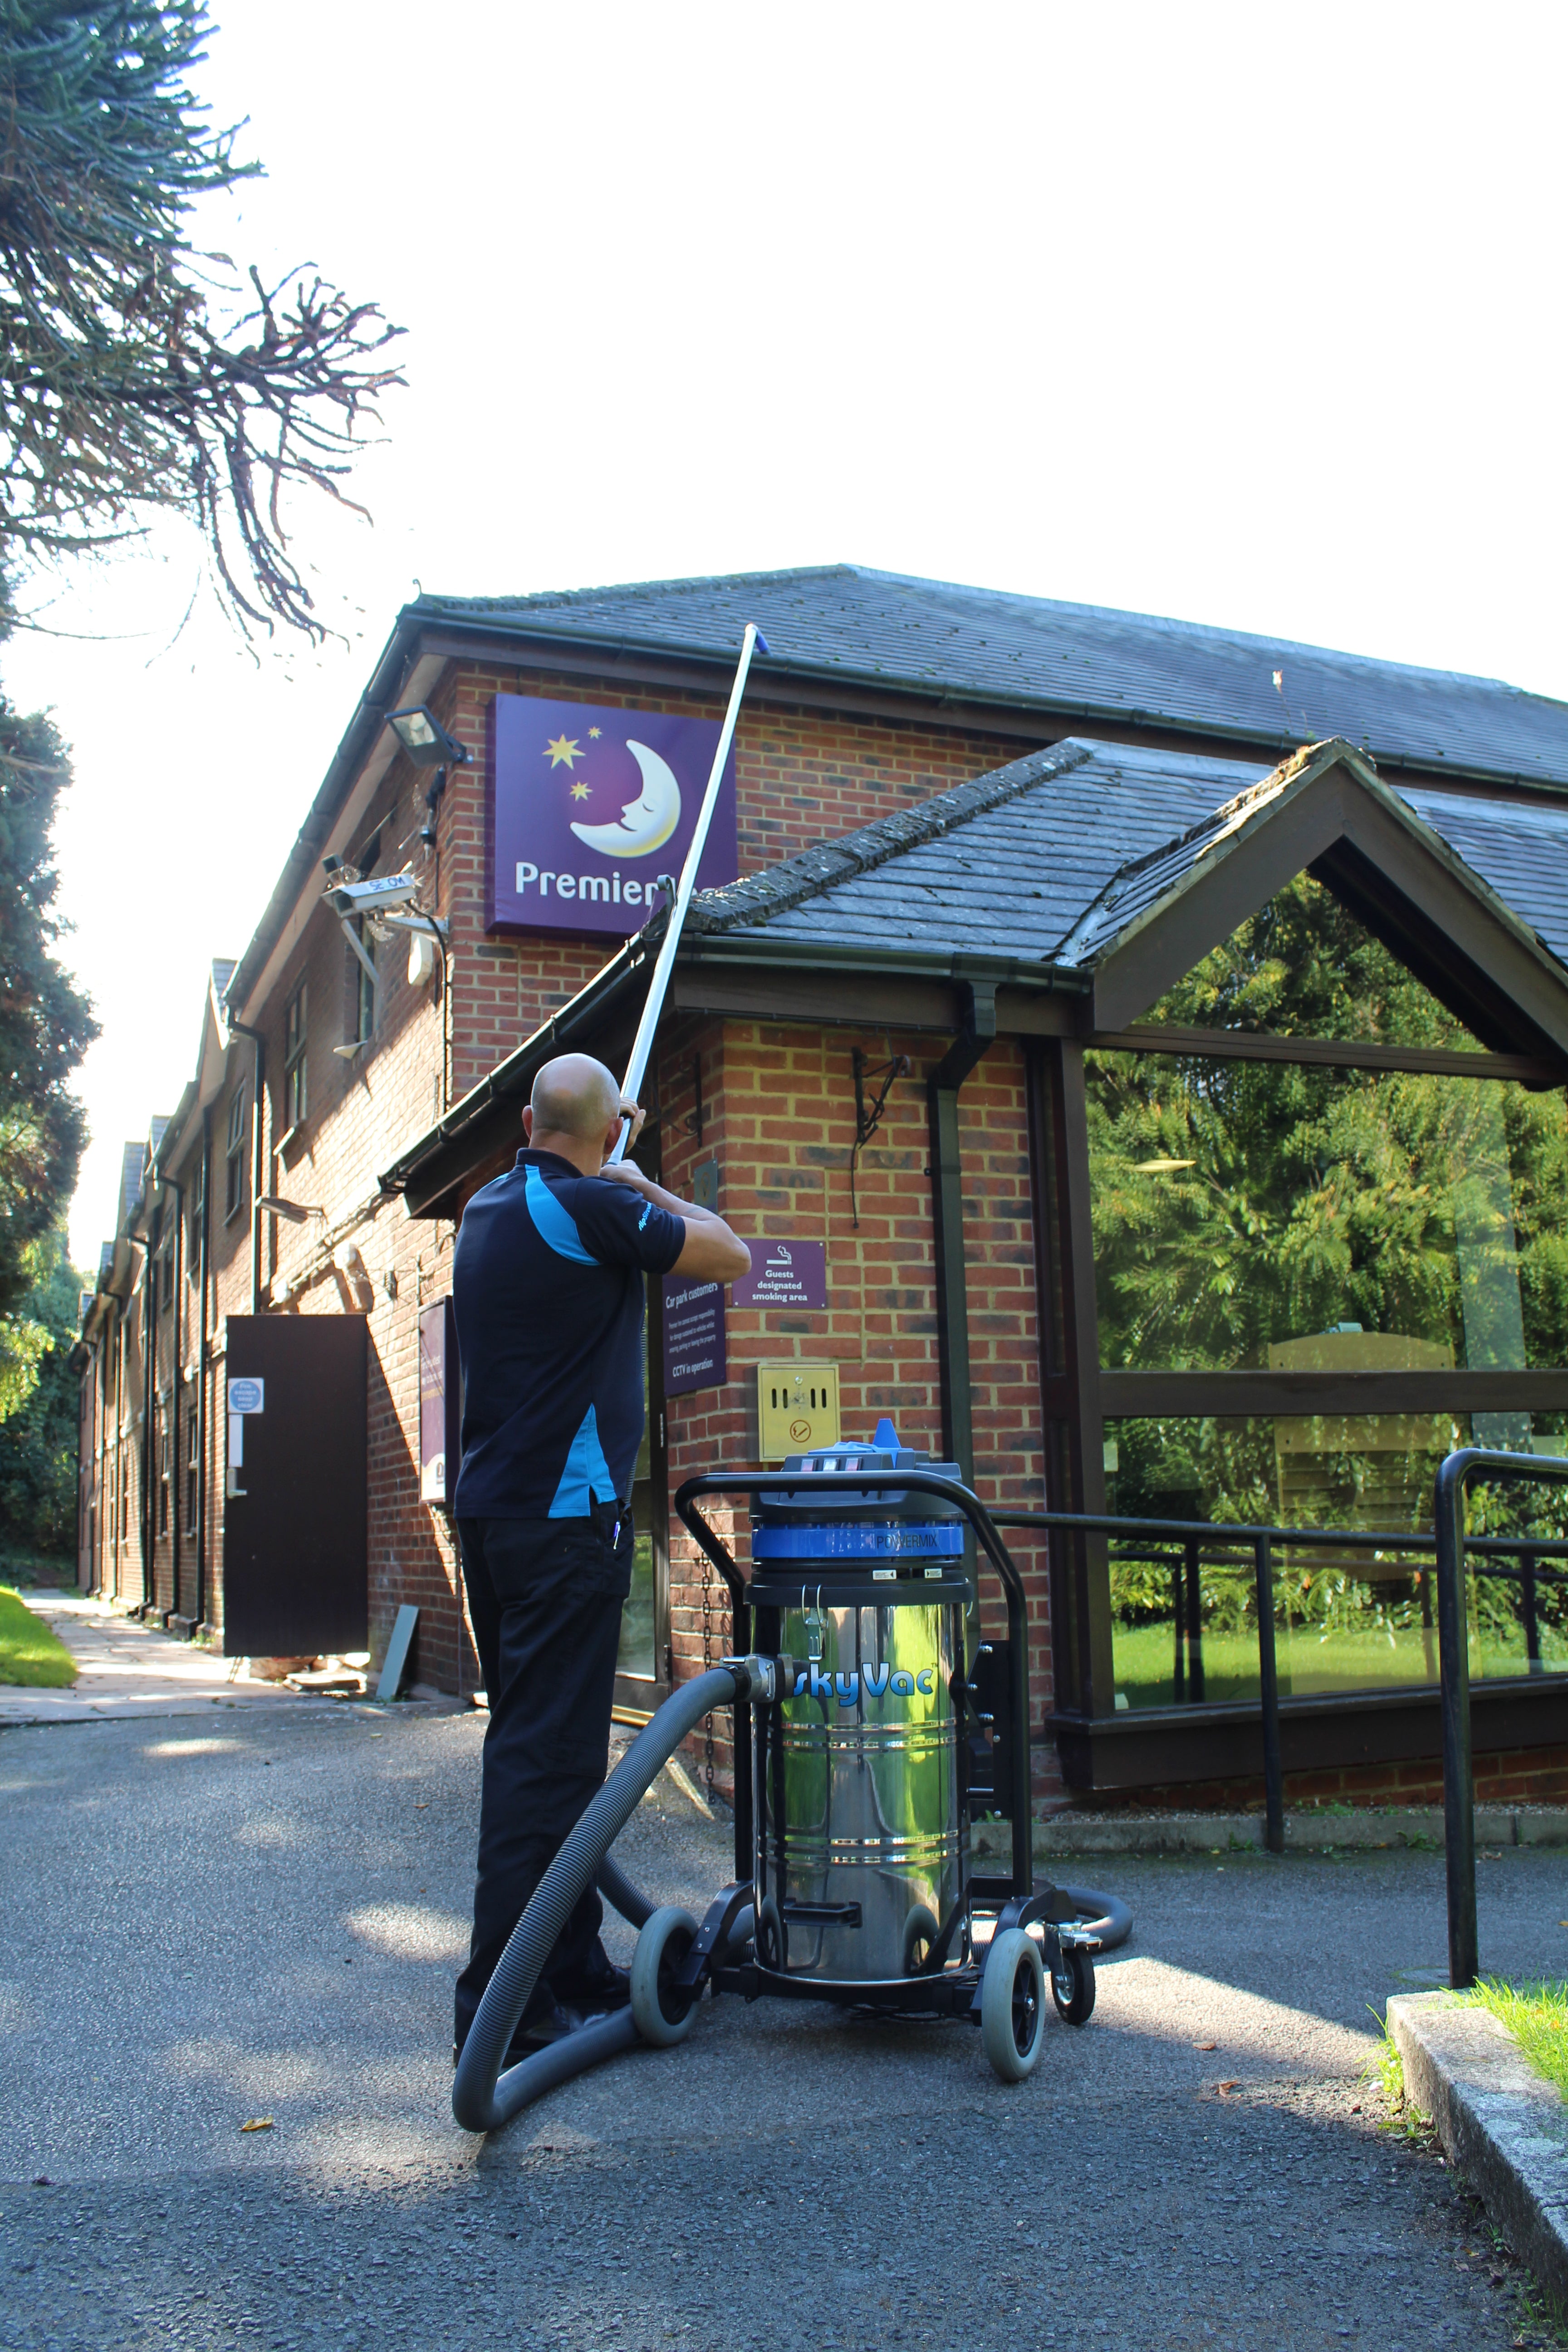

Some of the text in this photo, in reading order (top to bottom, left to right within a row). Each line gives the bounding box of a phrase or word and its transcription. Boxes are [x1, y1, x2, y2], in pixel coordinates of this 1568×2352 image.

[515, 862, 657, 906] Premier
[765, 1269, 794, 1278] Guests
[757, 1281, 802, 1291] designated
[666, 1282, 718, 1309] Car park customers
[752, 1292, 788, 1303] smoking
[672, 1358, 713, 1377] CCTV in operation
[877, 1534, 937, 1549] POWERMIX
[794, 1662, 933, 1707] skyVac
